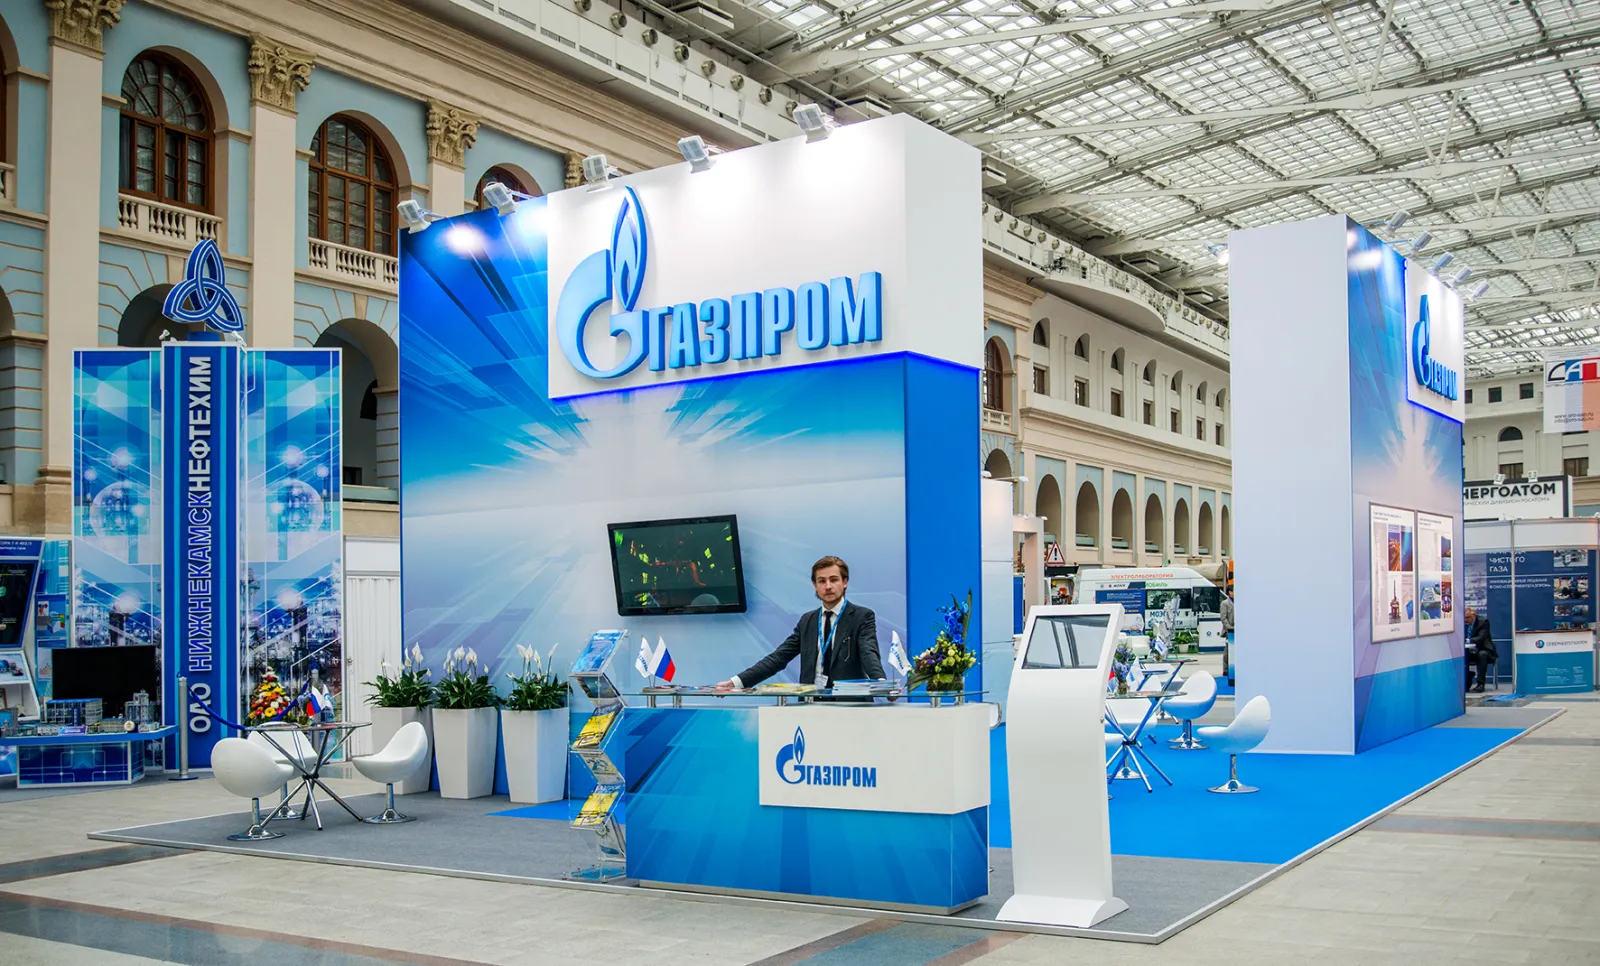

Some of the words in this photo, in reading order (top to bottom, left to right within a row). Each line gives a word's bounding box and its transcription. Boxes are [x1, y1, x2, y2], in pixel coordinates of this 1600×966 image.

[649, 271, 882, 372] ГАЗПРОМ
[188, 356, 212, 672] НИЖНЕКАМСКНЕФТЕХИМ
[1489, 556, 1526, 564] ЧИСТГО
[190, 682, 212, 733] ОАО
[806, 765, 877, 788] ГАЗПРОМ
